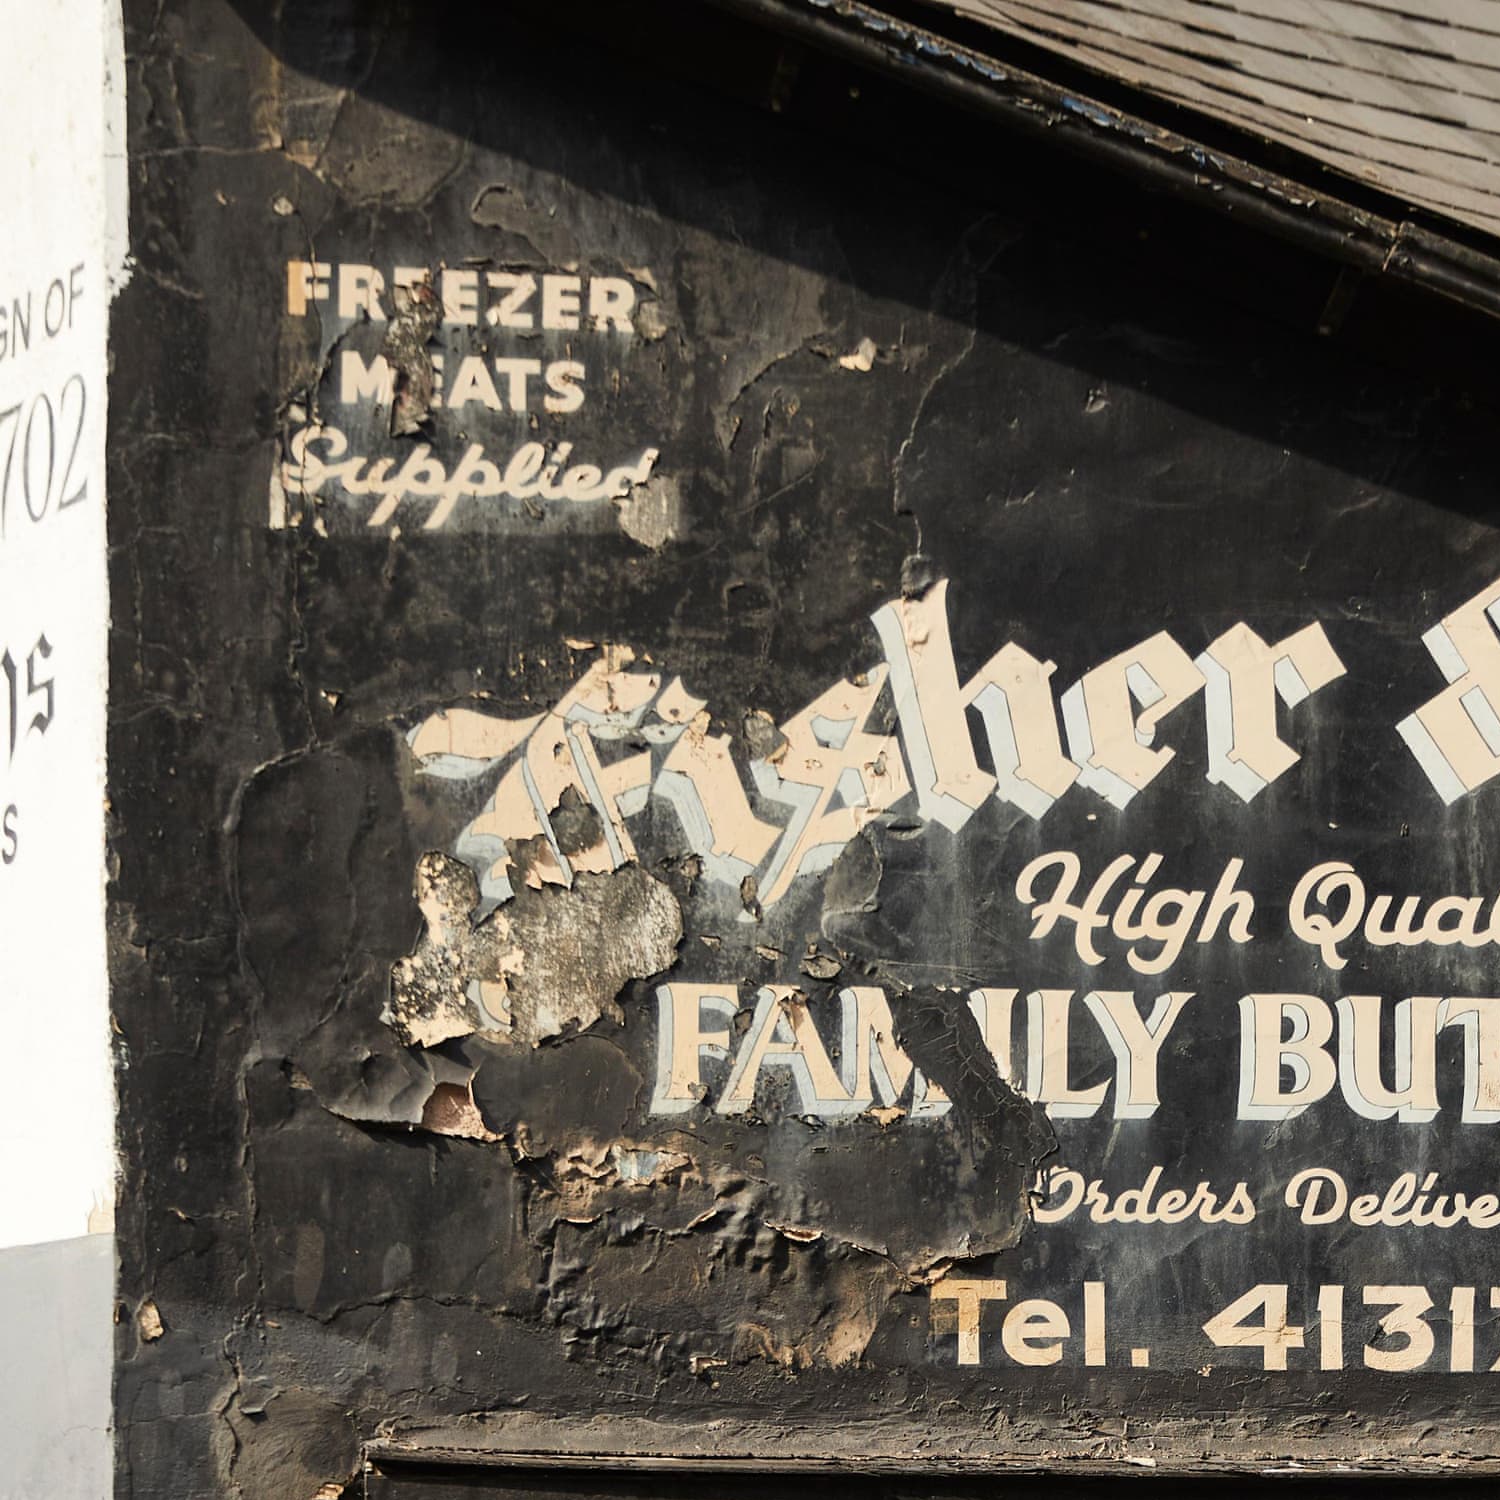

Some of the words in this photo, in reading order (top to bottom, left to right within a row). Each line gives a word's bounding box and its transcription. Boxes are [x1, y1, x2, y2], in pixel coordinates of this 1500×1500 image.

[45, 262, 85, 338] OF
[341, 349, 586, 414] MATS
[282, 425, 660, 530] Supplied
[1015, 851, 1254, 975] High
[1031, 1165, 1256, 1226] Orders
[930, 1279, 1149, 1367] Tel.
